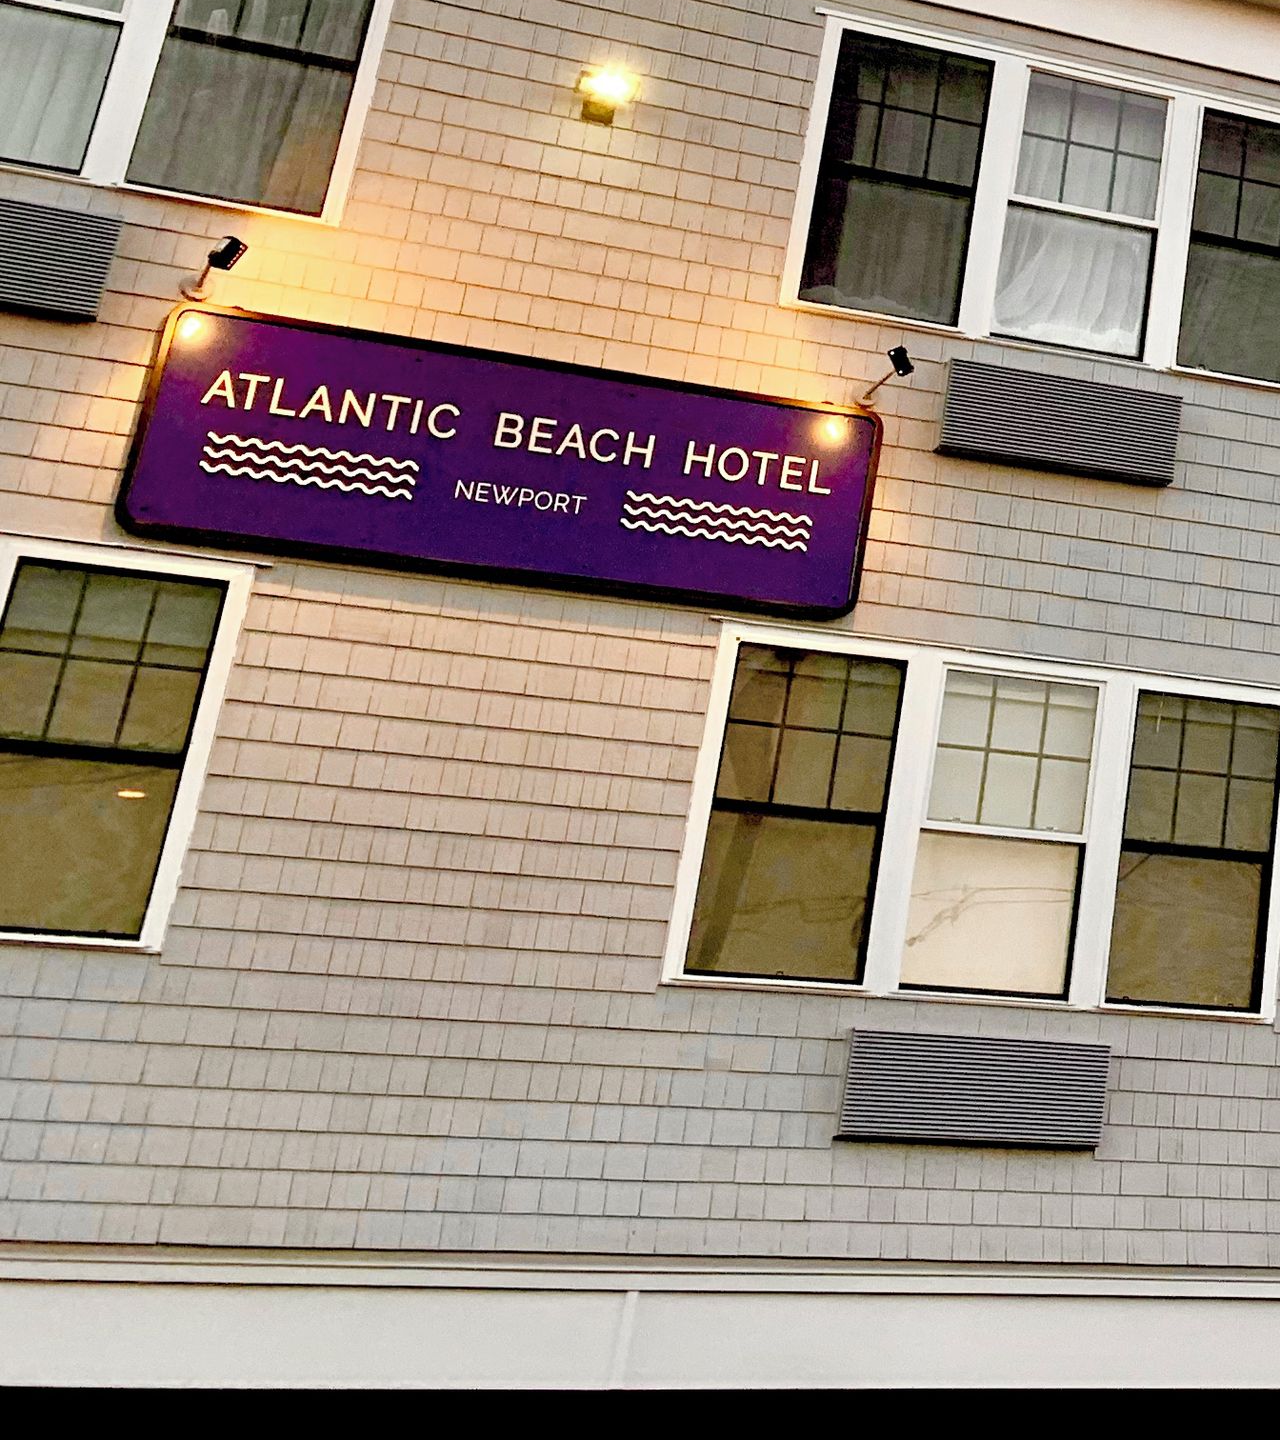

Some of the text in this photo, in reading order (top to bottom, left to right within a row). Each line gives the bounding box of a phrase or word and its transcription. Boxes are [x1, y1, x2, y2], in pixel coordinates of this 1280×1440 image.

[201, 370, 831, 494] ATLANTIC BEACH HOTEL
[454, 479, 588, 514] NEWPORT
